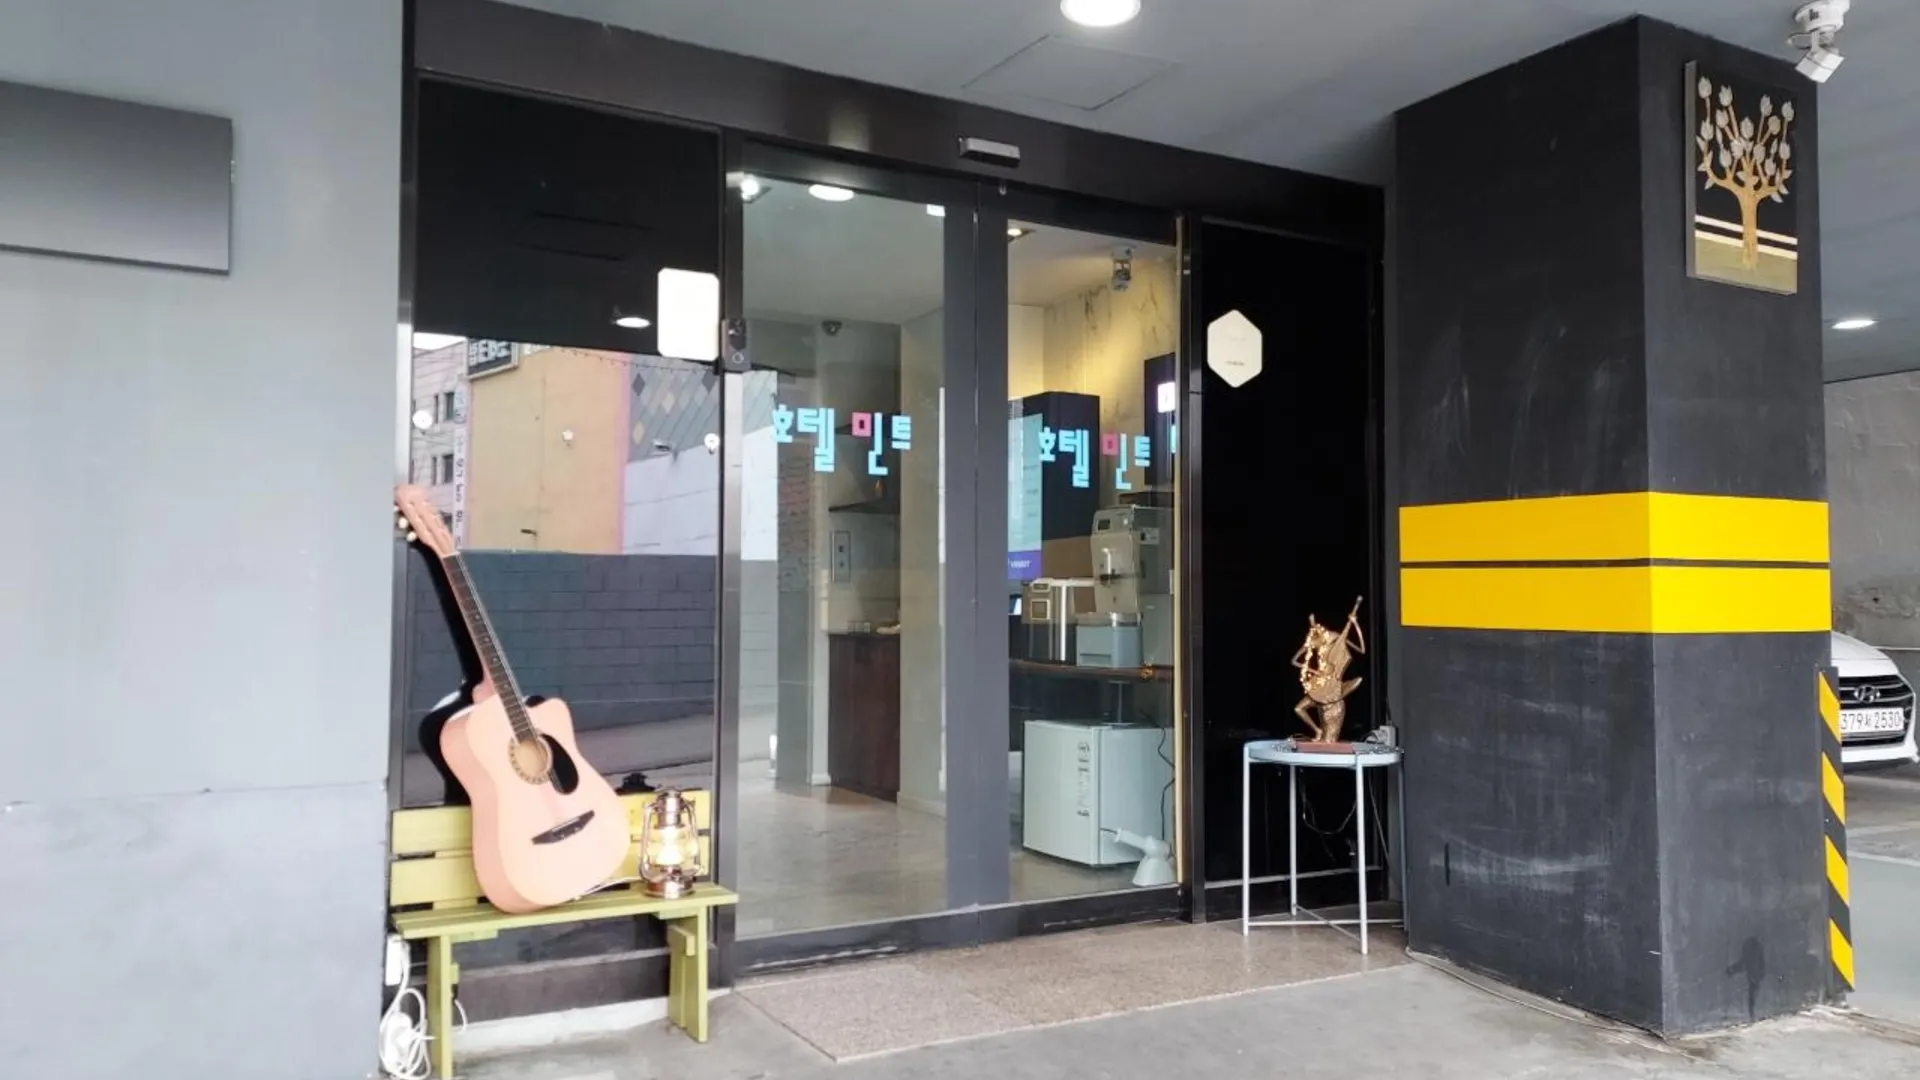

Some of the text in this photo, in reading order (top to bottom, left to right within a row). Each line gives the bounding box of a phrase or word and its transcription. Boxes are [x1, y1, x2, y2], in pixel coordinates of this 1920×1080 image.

[773, 404, 911, 475] 호텔 민트
[1039, 426, 1150, 490] 호텔 민트
